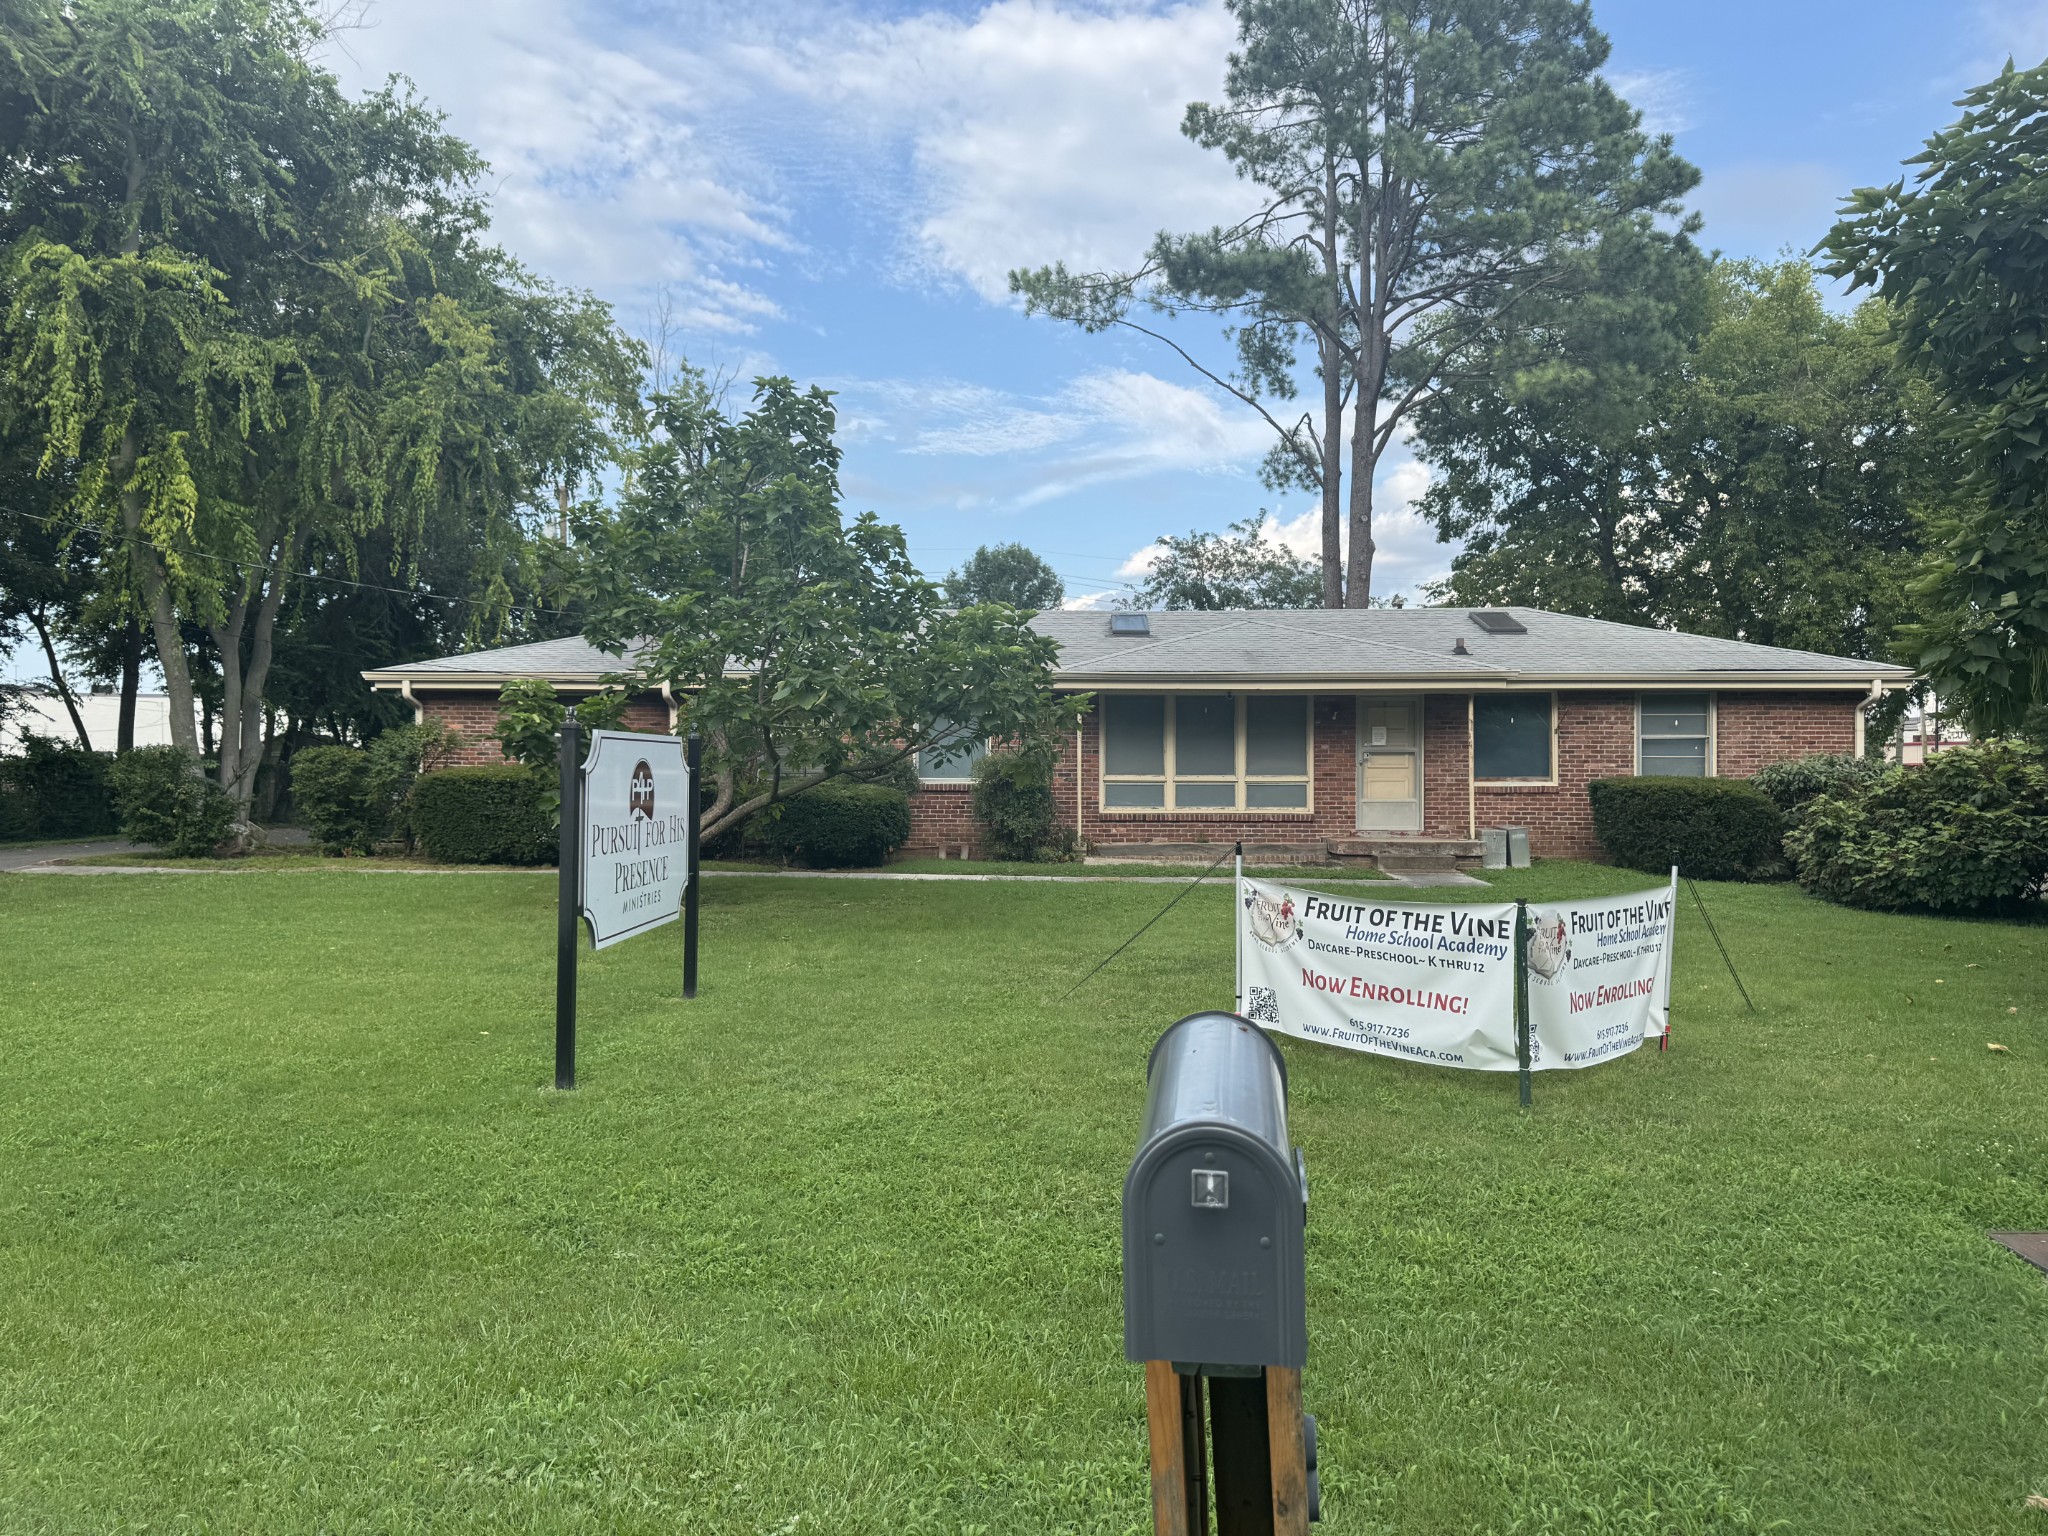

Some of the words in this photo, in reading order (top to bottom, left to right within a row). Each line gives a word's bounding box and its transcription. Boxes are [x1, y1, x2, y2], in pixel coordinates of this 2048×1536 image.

[592, 816, 644, 857] PURSUIT
[645, 820, 665, 848] FOR
[669, 815, 685, 844] HIS
[614, 856, 669, 894] PRESENCE
[622, 889, 662, 914] MINISTRIES
[1266, 912, 1290, 930] Vine
[1304, 896, 1365, 925] FRUIT
[1369, 908, 1397, 928] OF
[1401, 911, 1444, 934] THE
[1450, 911, 1510, 940] VINE
[1571, 911, 1604, 935] FRUIT
[1607, 909, 1621, 929] OF
[1622, 906, 1644, 926] THE
[1345, 925, 1387, 944] Home
[1387, 930, 1434, 950] School
[1436, 935, 1508, 961] Academy
[1597, 932, 1618, 948] Home
[1619, 924, 1641, 944] School
[1428, 955, 1438, 968] K
[1439, 957, 1471, 972] THRU
[1473, 962, 1485, 974] 12
[1302, 967, 1346, 995] NOW
[1349, 976, 1469, 1015] ENROLLING!
[1569, 990, 1596, 1014] NOW
[1349, 1018, 1410, 1039] 615.917.7236
[1597, 1022, 1629, 1040] 615.917.7236
[1209, 1269, 1263, 1296] MAIL
